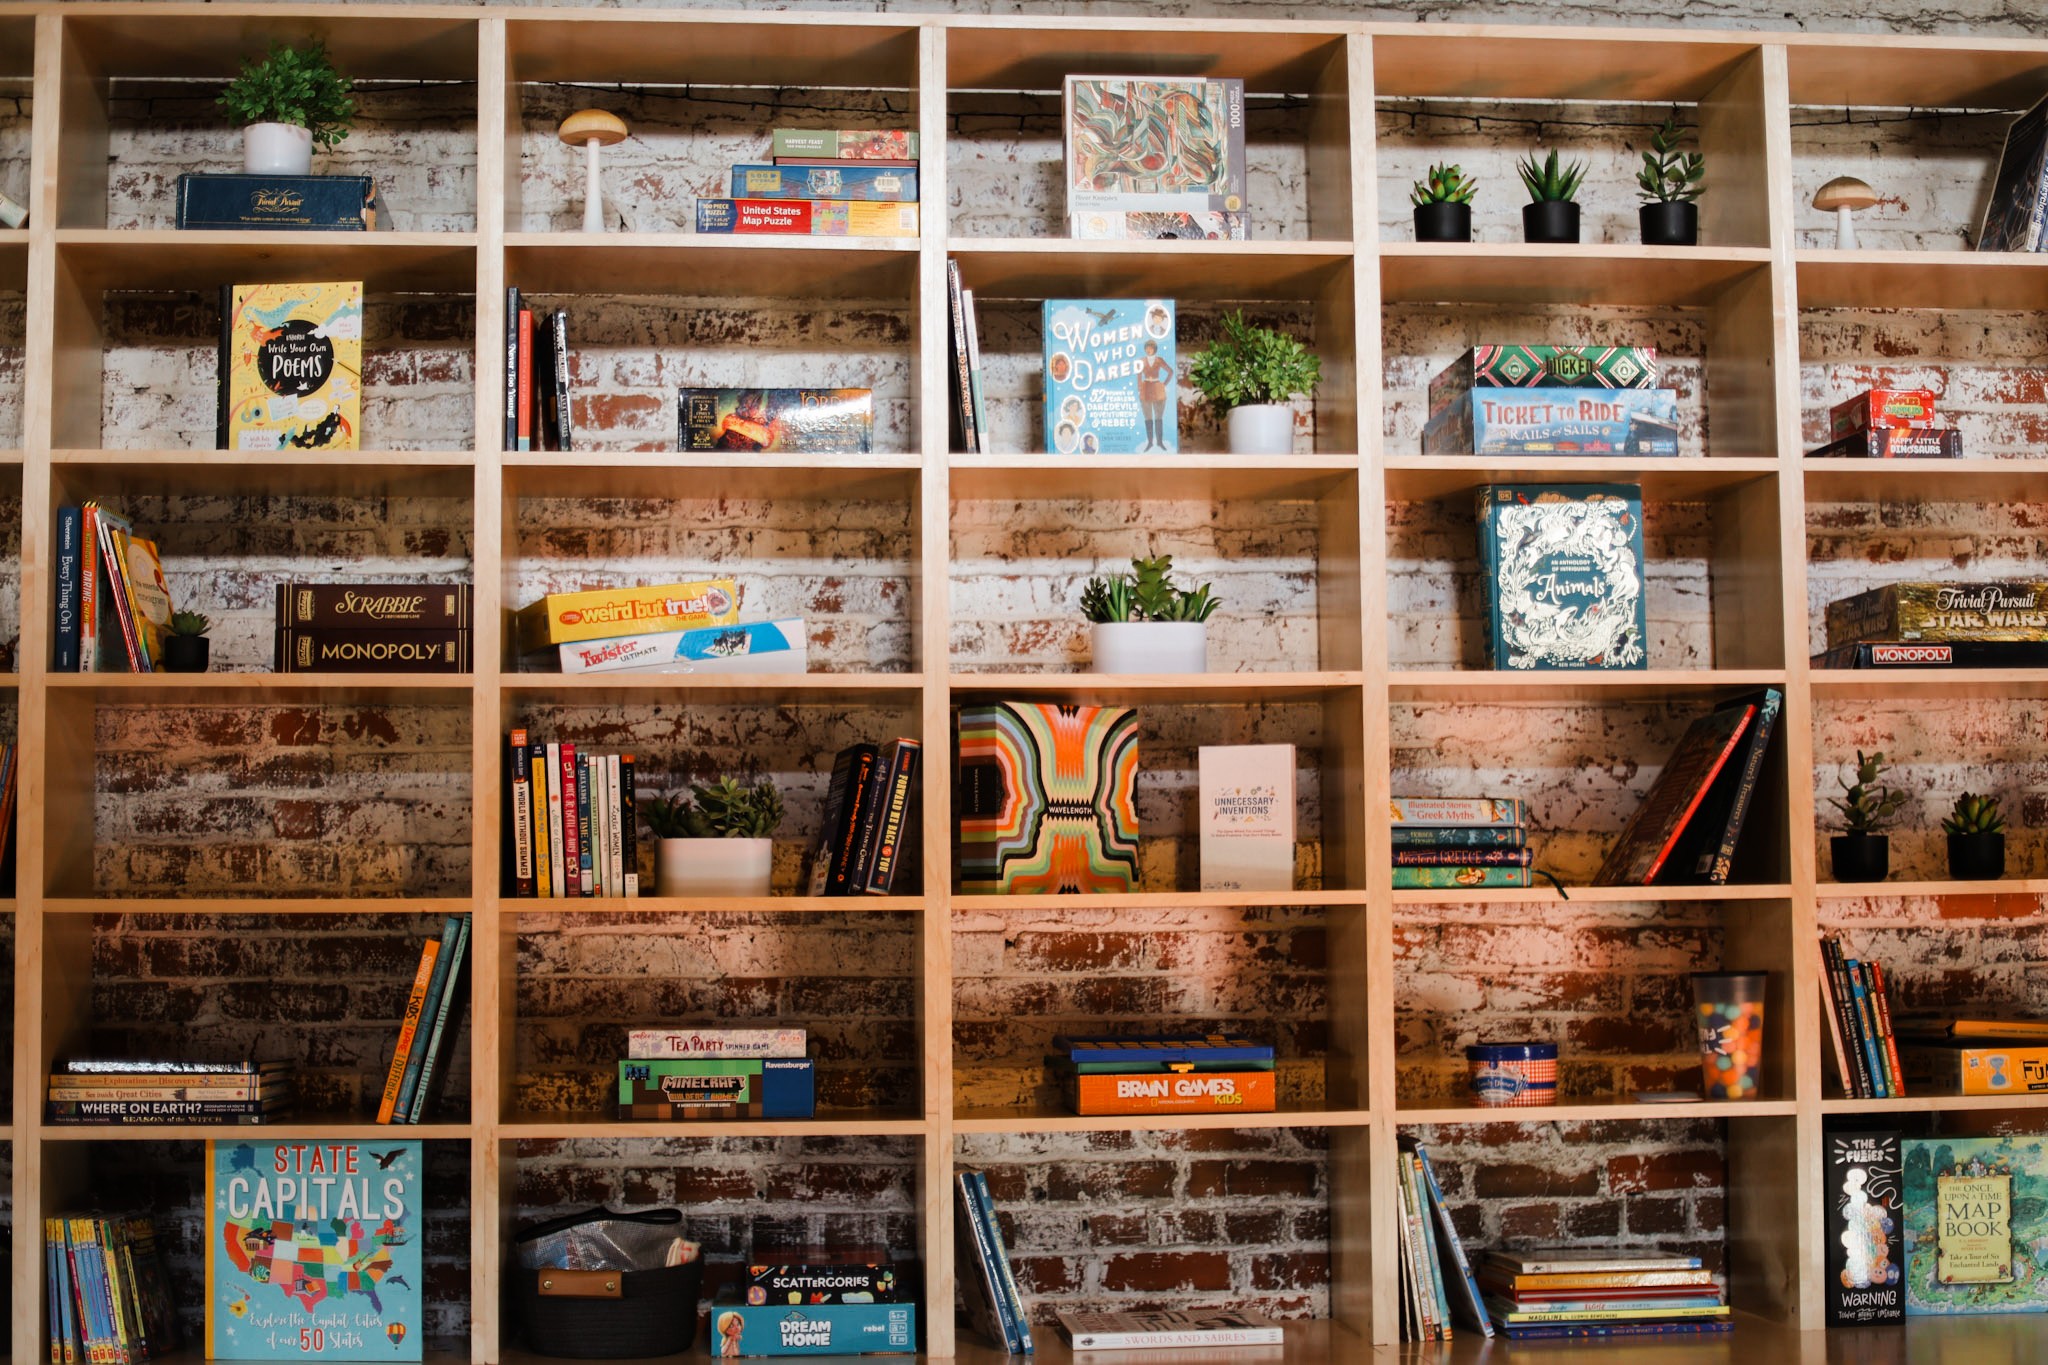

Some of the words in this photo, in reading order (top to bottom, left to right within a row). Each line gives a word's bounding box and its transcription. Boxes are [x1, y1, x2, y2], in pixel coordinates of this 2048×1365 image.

[1230, 104, 1240, 129] 1000
[743, 206, 772, 215] United
[773, 206, 801, 216] States
[743, 216, 762, 226] Map
[764, 217, 793, 226] Puzzle
[1053, 321, 1144, 352] WOMEN
[268, 344, 288, 354] Write
[290, 343, 307, 354] Your
[310, 342, 327, 353] Own
[1094, 344, 1136, 364] WHO
[508, 344, 516, 370] Never
[272, 354, 323, 380] POEMS
[1545, 355, 1594, 377] WICKED
[508, 372, 516, 388] Too
[960, 364, 968, 388] SOCIAL
[1072, 359, 1144, 391] DARED
[507, 388, 516, 418] Young!
[962, 390, 971, 416] ACTION
[1090, 389, 1106, 402] 52
[1482, 401, 1554, 425] TICKET
[1558, 407, 1574, 419] TO
[1579, 400, 1624, 423] RIDE
[1101, 418, 1136, 428] REBELS
[1510, 429, 1550, 440] RAILS
[1564, 425, 1600, 438] SAILS
[1890, 445, 1942, 454] DINOSAURS
[64, 516, 72, 550] Silverstein
[60, 555, 74, 580] Every
[82, 569, 92, 602] DARING
[1536, 574, 1606, 605] Animals
[60, 580, 73, 609] Thing
[1936, 588, 1986, 612] Trivial
[1980, 586, 2036, 615] Pursuit
[335, 590, 424, 620] SCRABBLE
[581, 602, 632, 624] weird
[636, 600, 664, 618] but
[666, 594, 710, 614] true!
[60, 610, 70, 625] On
[688, 613, 708, 621] GAME
[1920, 612, 1984, 628] STAR
[1988, 612, 2048, 628] WARS
[322, 643, 437, 660] MONOPOLY
[578, 640, 638, 668] Twister
[620, 646, 658, 662] ULTIMATE
[1875, 649, 1949, 662] MONOPOLY
[891, 774, 908, 810] FORWARD
[518, 792, 526, 814] WORLD
[1048, 806, 1092, 814] WAVELENGTH
[1214, 798, 1274, 806] UNNECESSARY
[1220, 806, 1269, 815] INVENTIONS
[1408, 801, 1446, 809] Illustrated
[1446, 801, 1472, 809] Stories
[888, 810, 900, 824] ME
[1416, 811, 1443, 820] Greek
[1444, 810, 1474, 822] Myths
[519, 815, 527, 846] WITHOUT
[580, 816, 588, 839] TIME
[884, 824, 898, 846] BACK
[612, 832, 620, 857] WOMEN
[520, 846, 528, 876] SUMMER
[878, 856, 891, 873] YOU
[405, 996, 423, 1020] KIDS
[398, 1027, 414, 1054] DARE
[665, 1035, 690, 1052] TEA
[690, 1035, 724, 1052] PARTY
[765, 1061, 810, 1070] Ravensburger
[104, 1077, 148, 1086] Exploration
[158, 1076, 196, 1086] Discovery
[664, 1077, 746, 1089] MINECRAFT
[1175, 1079, 1235, 1097] GAMES
[116, 1090, 138, 1100] Great
[140, 1090, 162, 1098] Cities
[82, 1104, 126, 1114] WHERE
[130, 1103, 150, 1114] ON
[153, 1103, 202, 1114] EARTH?
[1852, 1138, 1876, 1149] THE
[274, 1145, 359, 1174] STATE
[1964, 1184, 1992, 1192] ONCE
[228, 1177, 406, 1221] CAPITALS
[1946, 1202, 2002, 1220] MAP
[1945, 1222, 2004, 1237] BOOK
[772, 1276, 870, 1289] SCATTERGORIES
[250, 1312, 288, 1330] Explore
[287, 1312, 304, 1326] the
[312, 1312, 348, 1330] Capital
[355, 1312, 383, 1328] Cities
[780, 1320, 832, 1334] DREAM
[864, 1324, 886, 1332] rebel
[266, 1332, 277, 1350] of
[280, 1336, 297, 1346] our
[300, 1328, 326, 1352] 50
[329, 1331, 364, 1348] States
[782, 1333, 832, 1346] HOME
[1125, 1335, 1173, 1345] SWORDS
[1176, 1334, 1200, 1344] AND
[1204, 1332, 1246, 1342] SABRES
